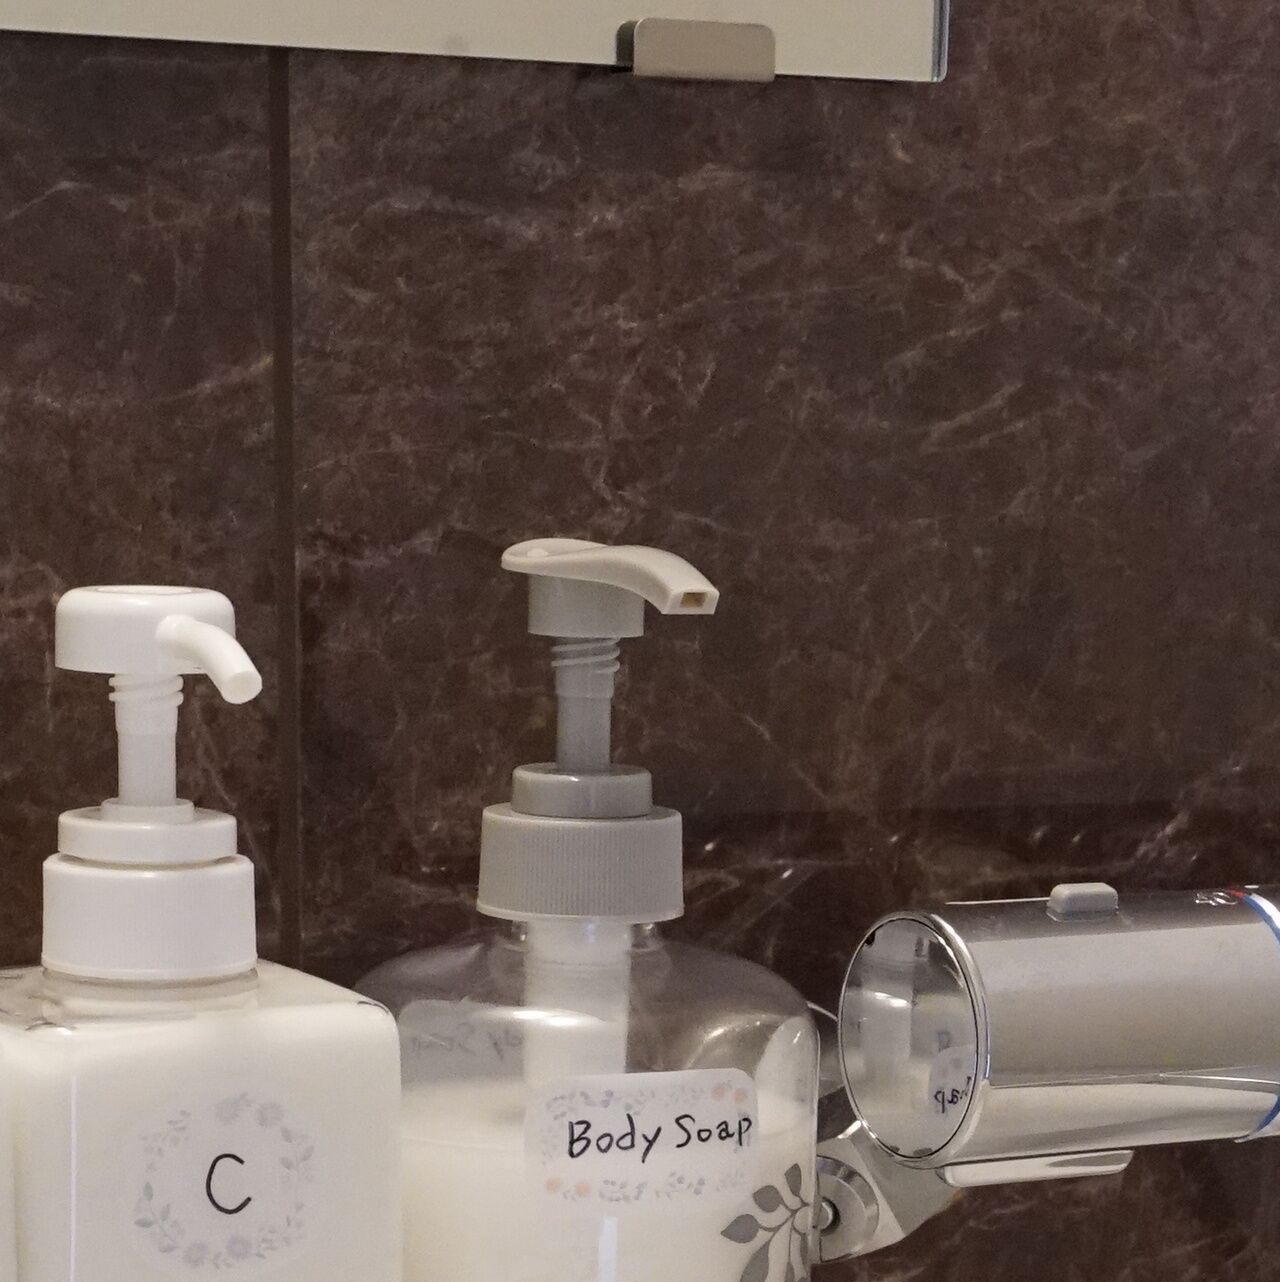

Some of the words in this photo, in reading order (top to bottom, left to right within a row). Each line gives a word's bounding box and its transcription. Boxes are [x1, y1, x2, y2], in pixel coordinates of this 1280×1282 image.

[567, 1112, 662, 1164] Body
[674, 1113, 753, 1148] Soap
[205, 1152, 252, 1215] C
